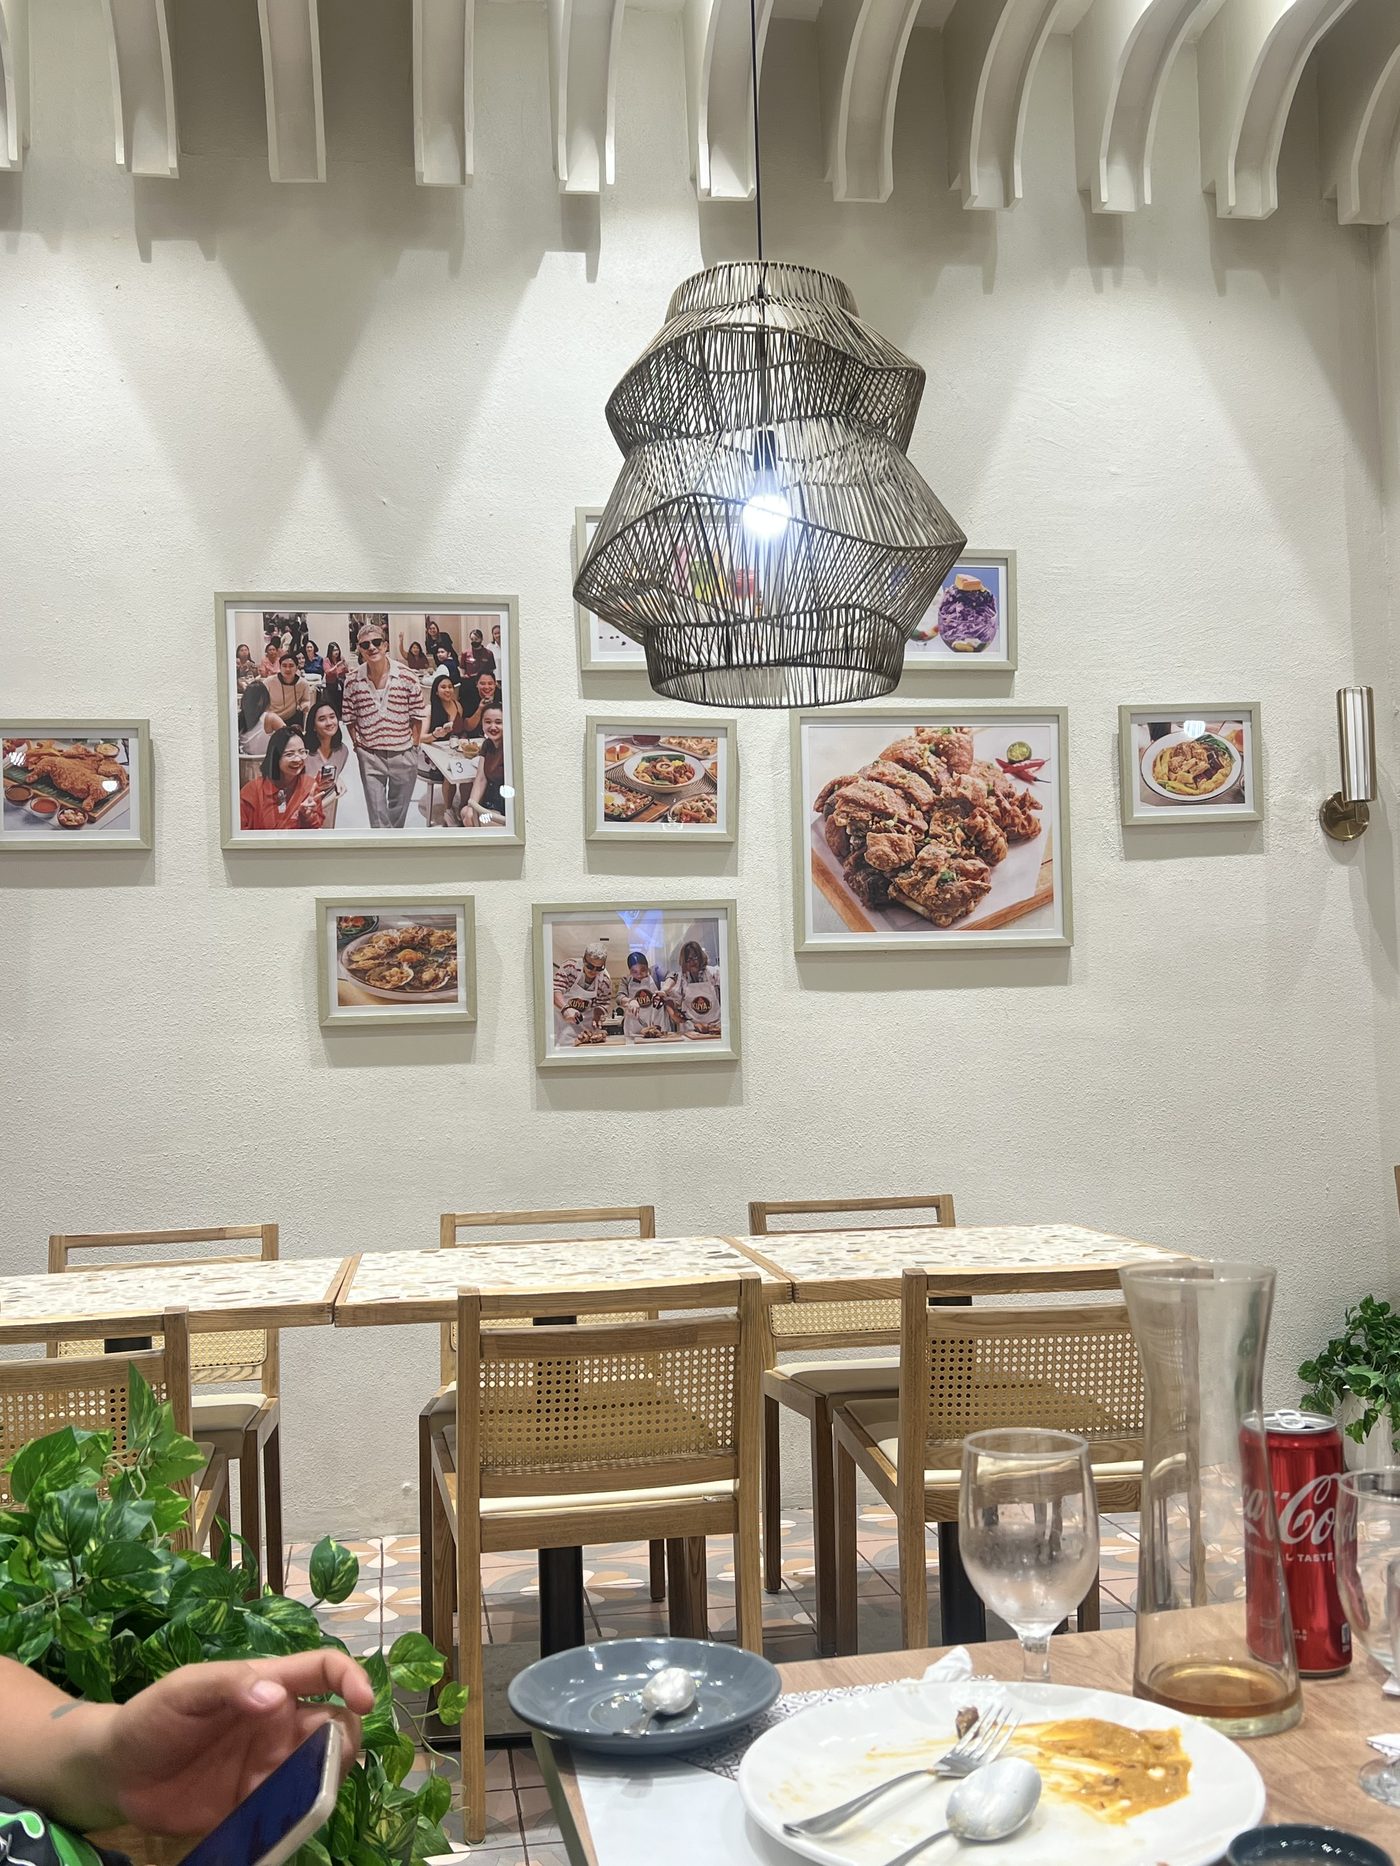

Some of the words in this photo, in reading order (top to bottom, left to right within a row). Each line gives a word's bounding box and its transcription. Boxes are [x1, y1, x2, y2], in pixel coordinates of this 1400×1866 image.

[455, 761, 464, 774] 3
[692, 1001, 707, 1010] KUYA
[1297, 1552, 1334, 1562] TASTE
